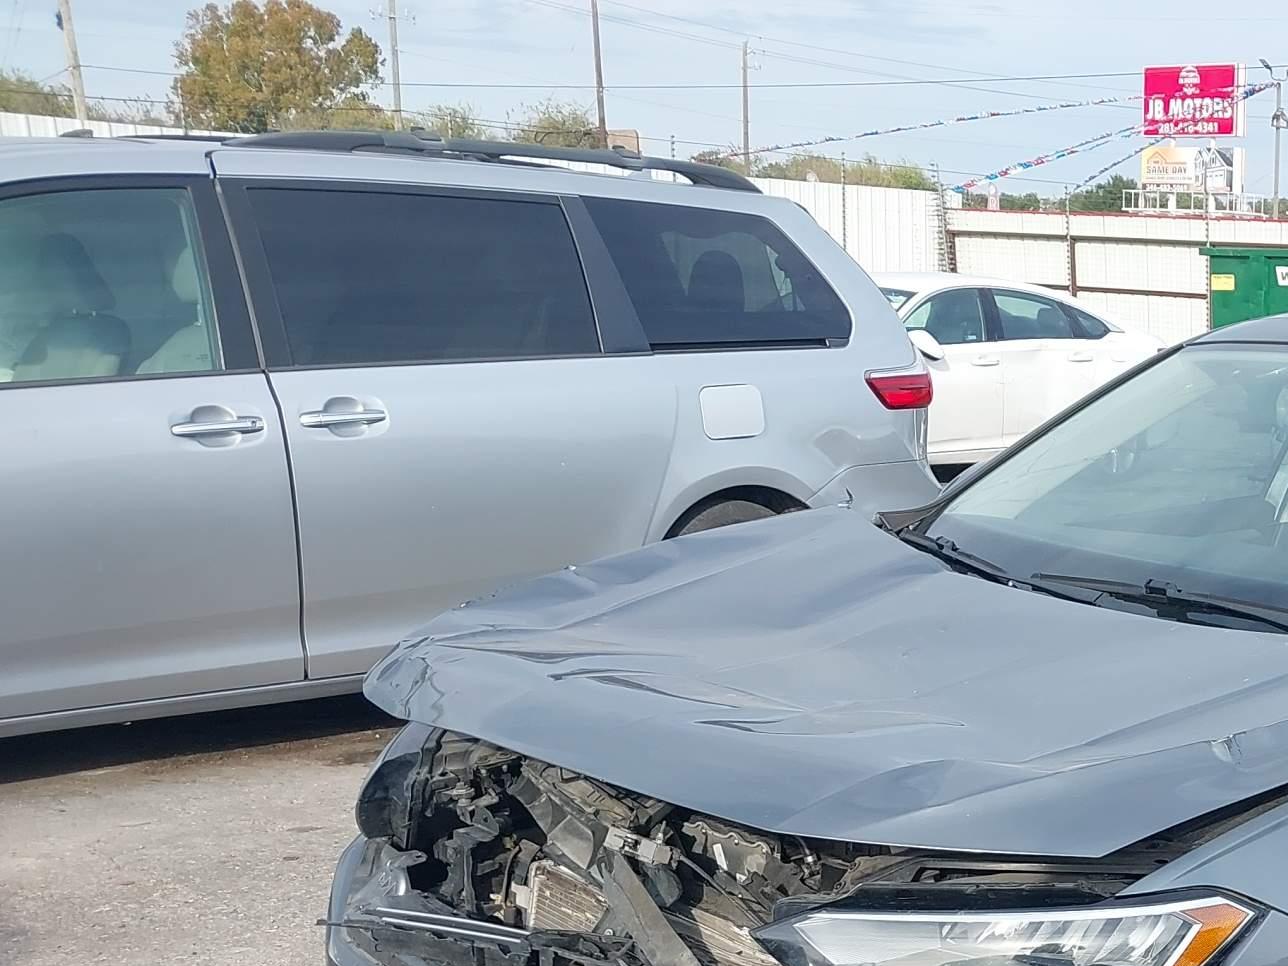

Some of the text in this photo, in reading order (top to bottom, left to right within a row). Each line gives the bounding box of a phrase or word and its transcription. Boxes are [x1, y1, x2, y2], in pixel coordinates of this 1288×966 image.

[1146, 97, 1233, 120] JB MOTORS
[1146, 165, 1187, 174] SAME DAY
